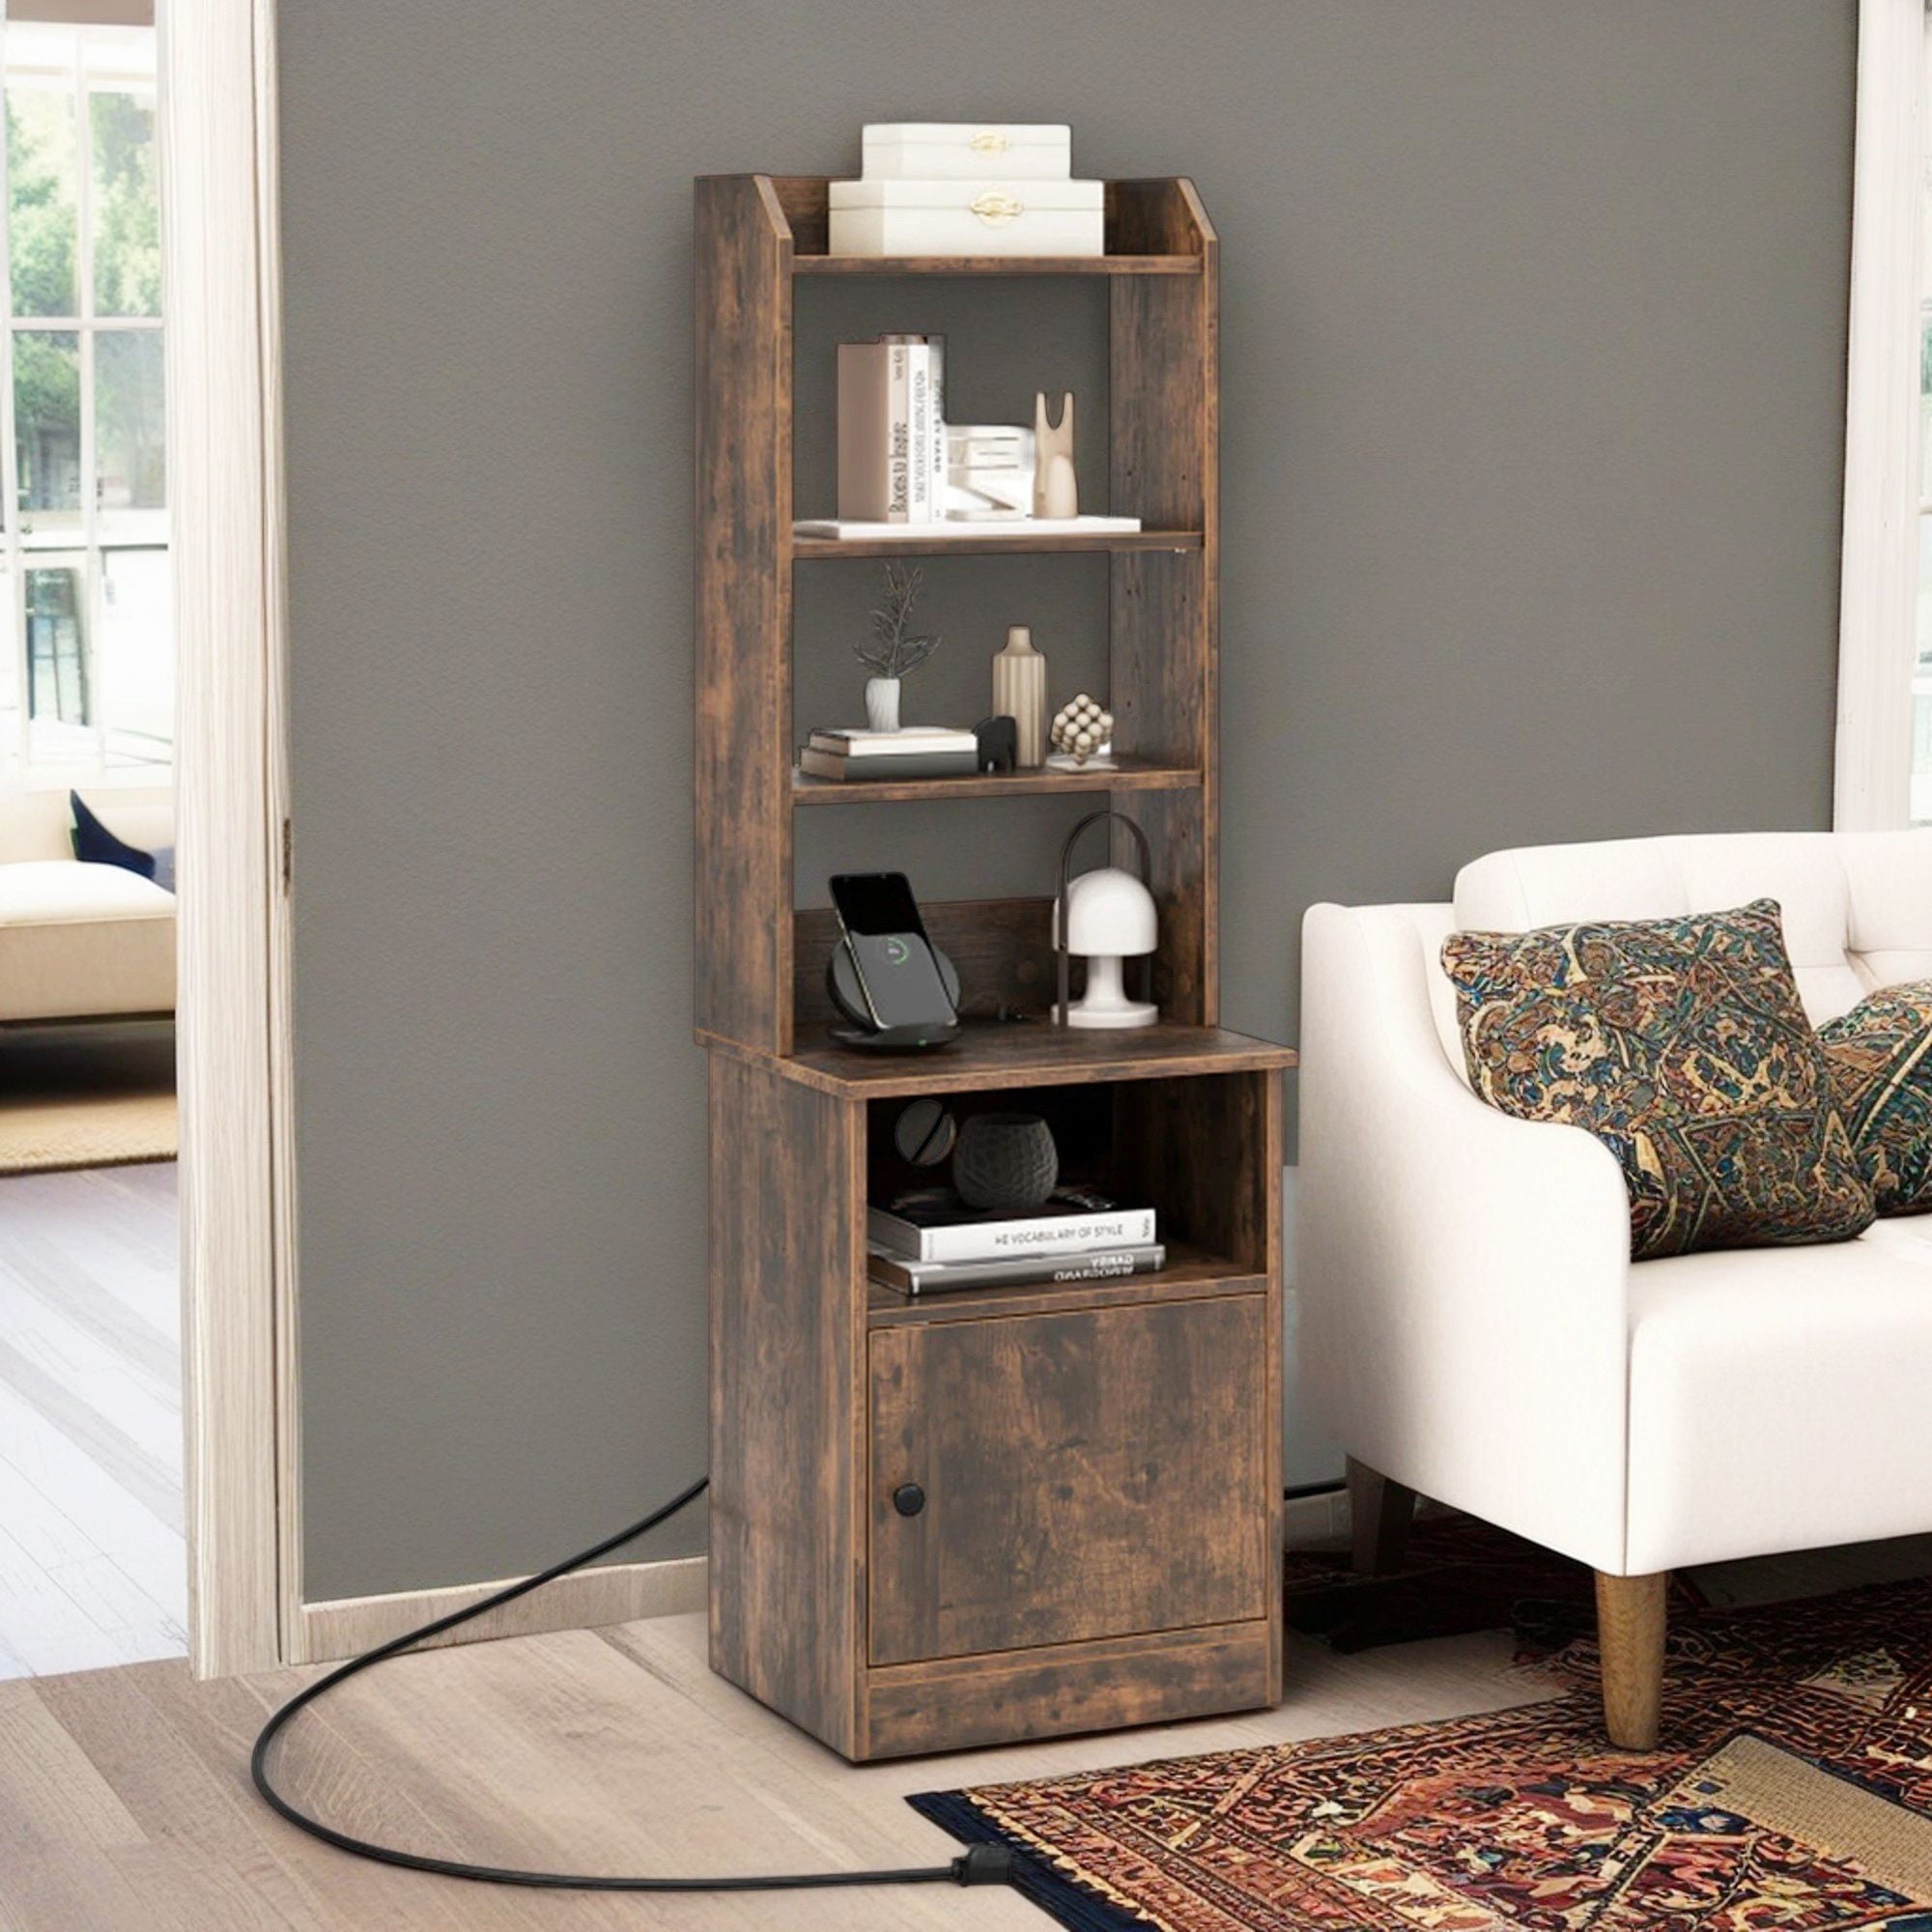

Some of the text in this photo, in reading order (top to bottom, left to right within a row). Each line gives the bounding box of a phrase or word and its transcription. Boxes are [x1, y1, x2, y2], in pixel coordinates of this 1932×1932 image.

[1011, 1228, 1076, 1244] VOCABULARY
[1078, 1226, 1092, 1238] OF
[1094, 1224, 1123, 1237] STYLE
